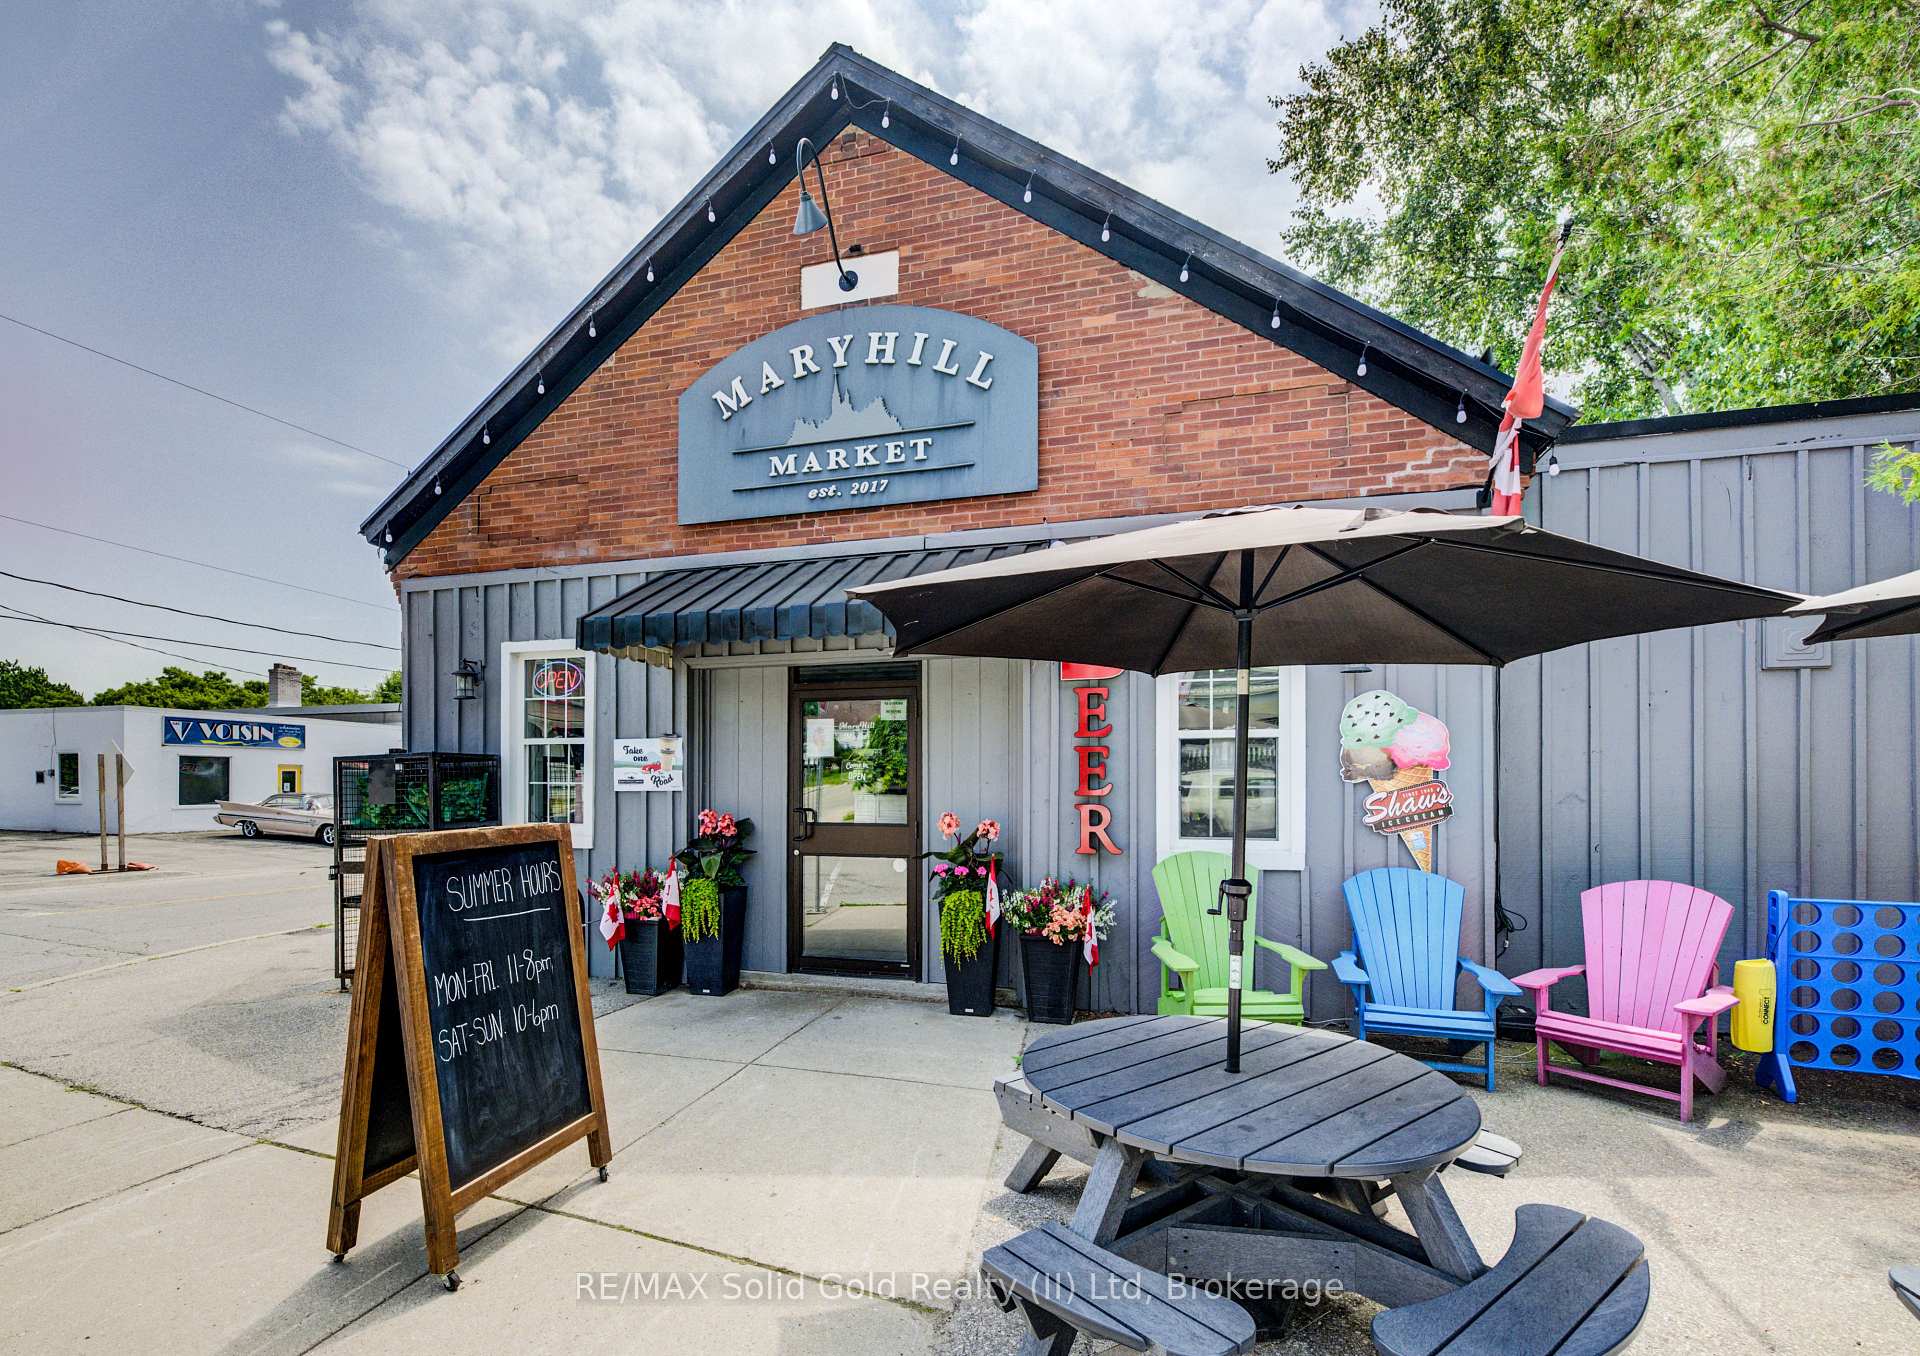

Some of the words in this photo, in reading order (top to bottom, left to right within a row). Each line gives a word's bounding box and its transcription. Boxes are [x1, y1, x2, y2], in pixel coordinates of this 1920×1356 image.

[711, 331, 995, 421] MARYHILL
[768, 437, 933, 477] MARKET
[807, 484, 842, 500] est.
[849, 479, 890, 496] 2017
[536, 670, 577, 689] OPEN
[198, 722, 275, 742] VOISIN
[622, 745, 644, 755] Take
[650, 774, 674, 788] Road
[1364, 786, 1450, 823] Shaw's
[1381, 818, 1401, 827] ICE
[1405, 809, 1444, 823] CREAM
[446, 867, 514, 912] SUMMER
[519, 860, 562, 899] HOURS
[513, 998, 559, 1034] 10-6pm
